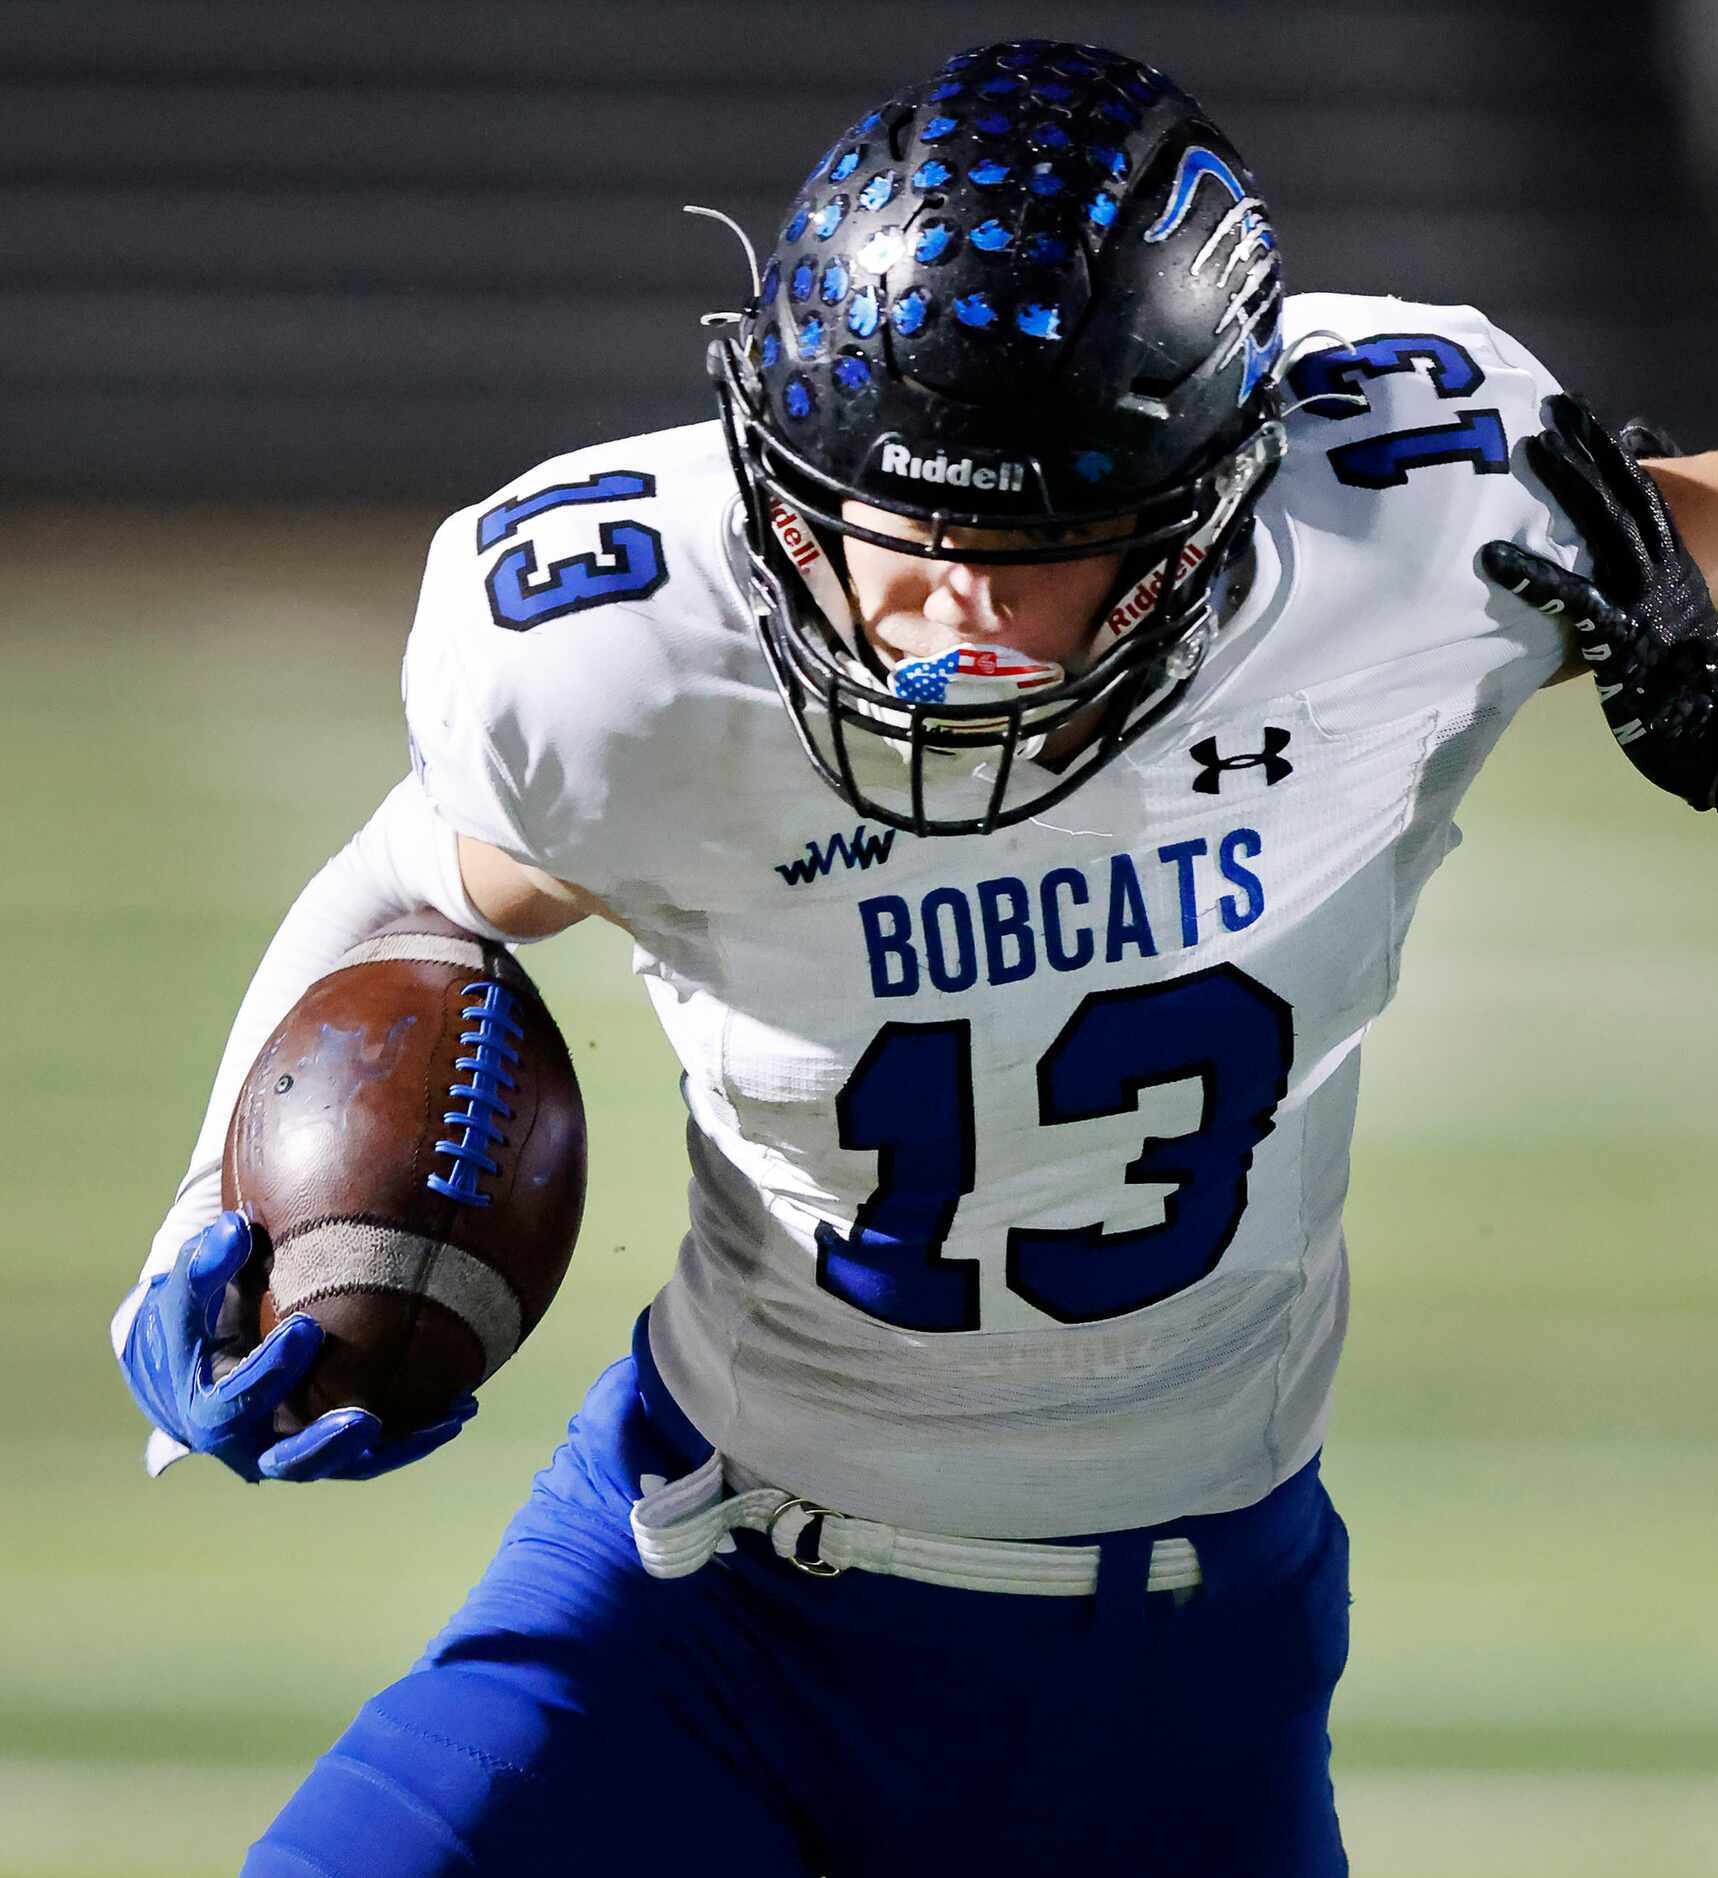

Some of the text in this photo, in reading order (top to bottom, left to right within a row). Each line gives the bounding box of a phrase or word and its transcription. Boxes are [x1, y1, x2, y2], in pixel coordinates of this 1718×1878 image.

[881, 442, 1024, 492] Riddell
[1286, 333, 1509, 489] 13
[476, 469, 670, 632] 13
[858, 827, 1264, 998] BOBCATS
[816, 961, 1295, 1333] 13
